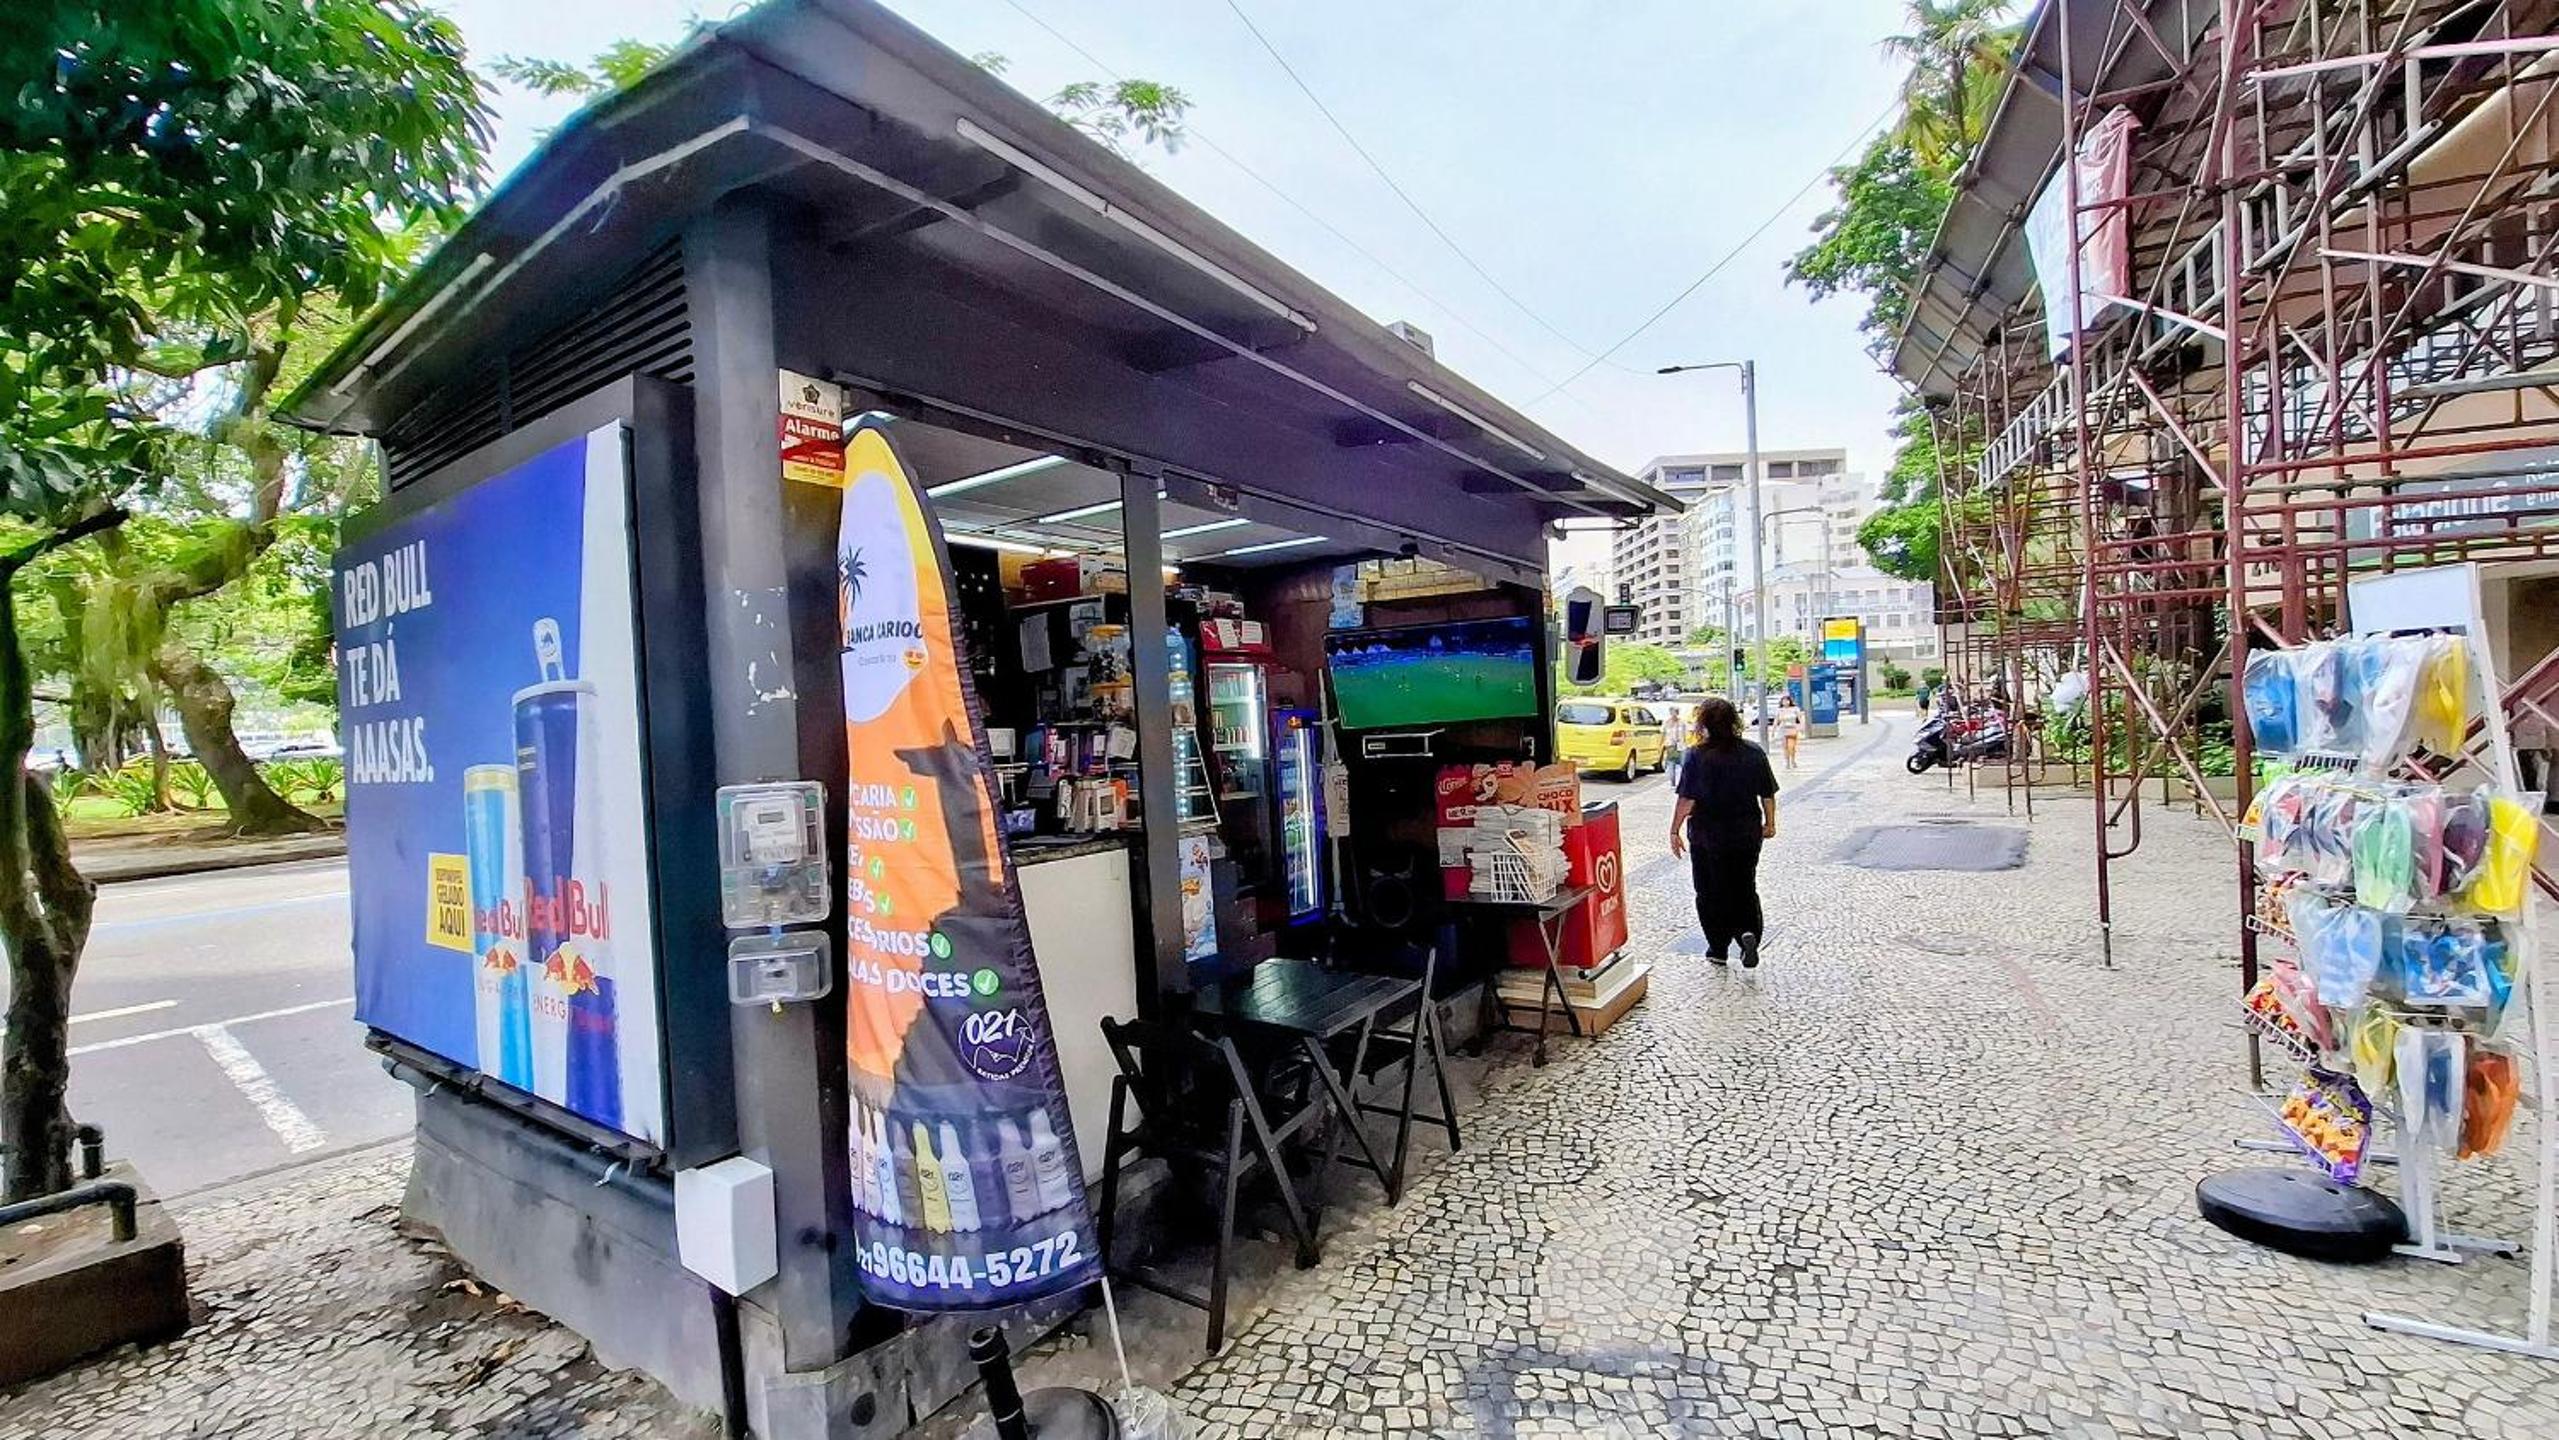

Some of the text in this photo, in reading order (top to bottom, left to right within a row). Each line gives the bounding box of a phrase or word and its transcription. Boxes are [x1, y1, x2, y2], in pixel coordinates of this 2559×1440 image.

[785, 418, 841, 441] Alarme
[343, 539, 433, 629] RED BULL
[347, 622, 401, 707] TE DÁ
[353, 715, 434, 784] AAASAS.
[1537, 788, 1575, 802] CHOCO
[439, 905, 466, 938] AQUI
[569, 878, 611, 941] Bull
[886, 968, 971, 998] DOCES
[966, 1007, 1017, 1045] 021
